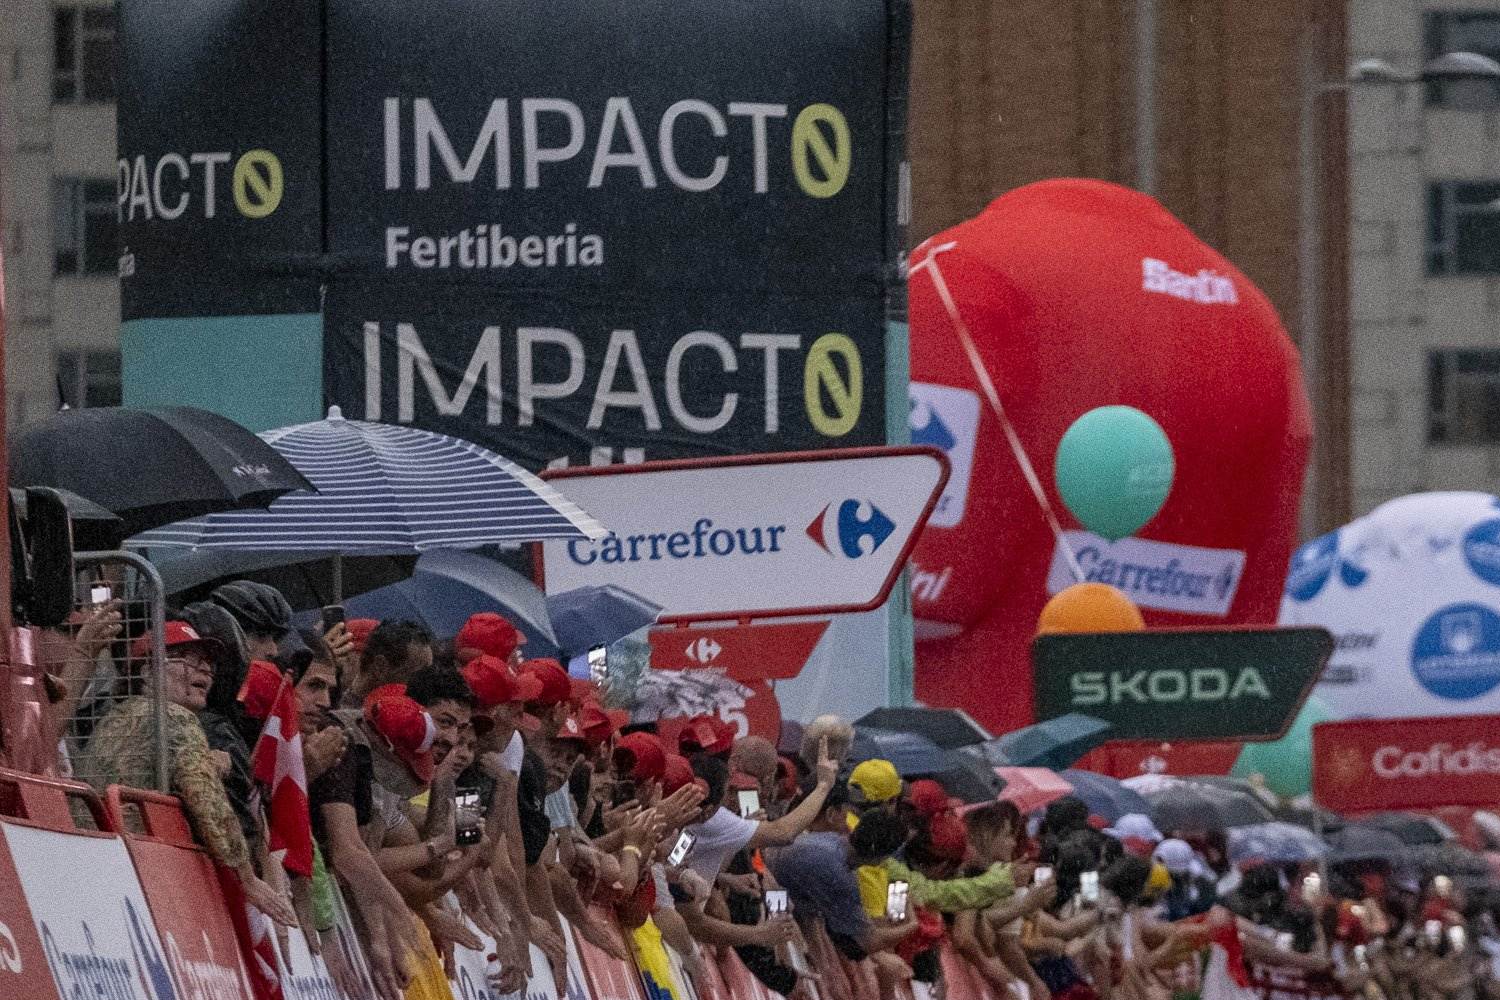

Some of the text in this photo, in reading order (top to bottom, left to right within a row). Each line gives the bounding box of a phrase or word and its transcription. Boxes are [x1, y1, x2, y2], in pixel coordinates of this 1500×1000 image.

[386, 224, 604, 269] Fertiberia
[567, 518, 786, 565] Carrefour
[1070, 667, 1271, 704] SKODA
